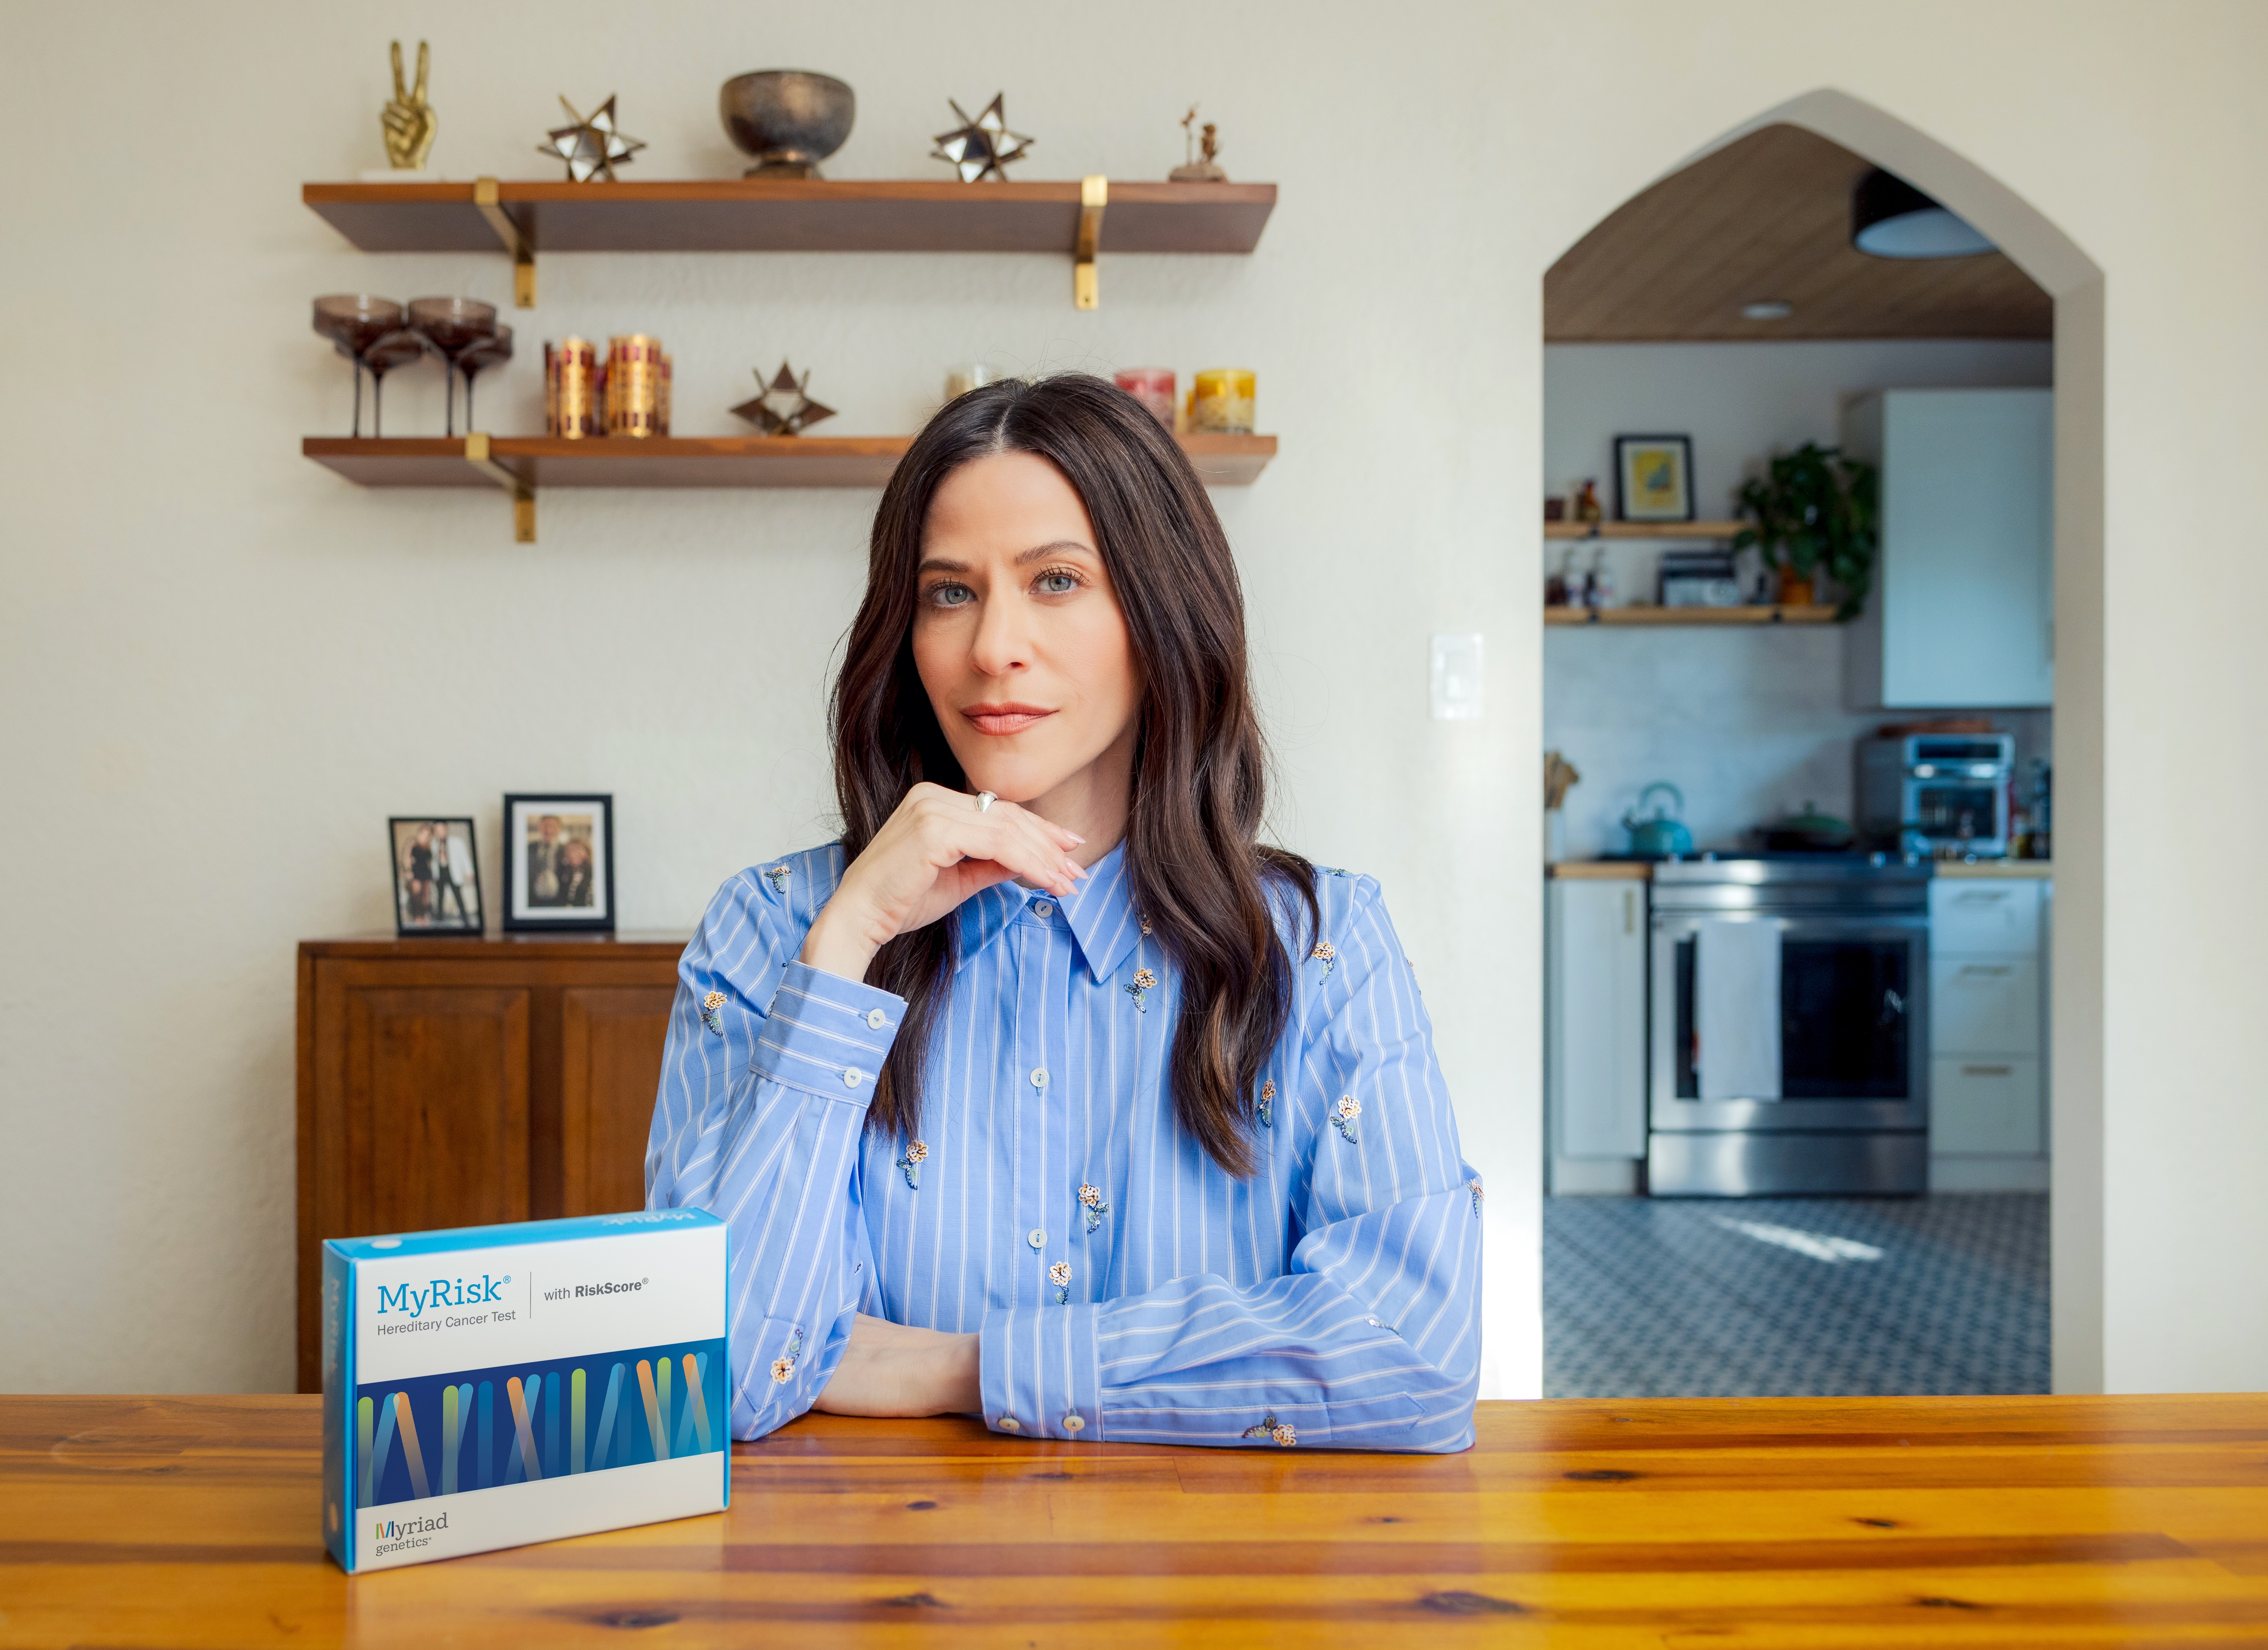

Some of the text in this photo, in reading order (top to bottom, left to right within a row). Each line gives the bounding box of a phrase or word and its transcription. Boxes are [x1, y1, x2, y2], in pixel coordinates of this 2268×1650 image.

[544, 1288, 570, 1301] with
[378, 1310, 516, 1335] Hereditary Cancer Test
[376, 1512, 448, 1541] Myriad
